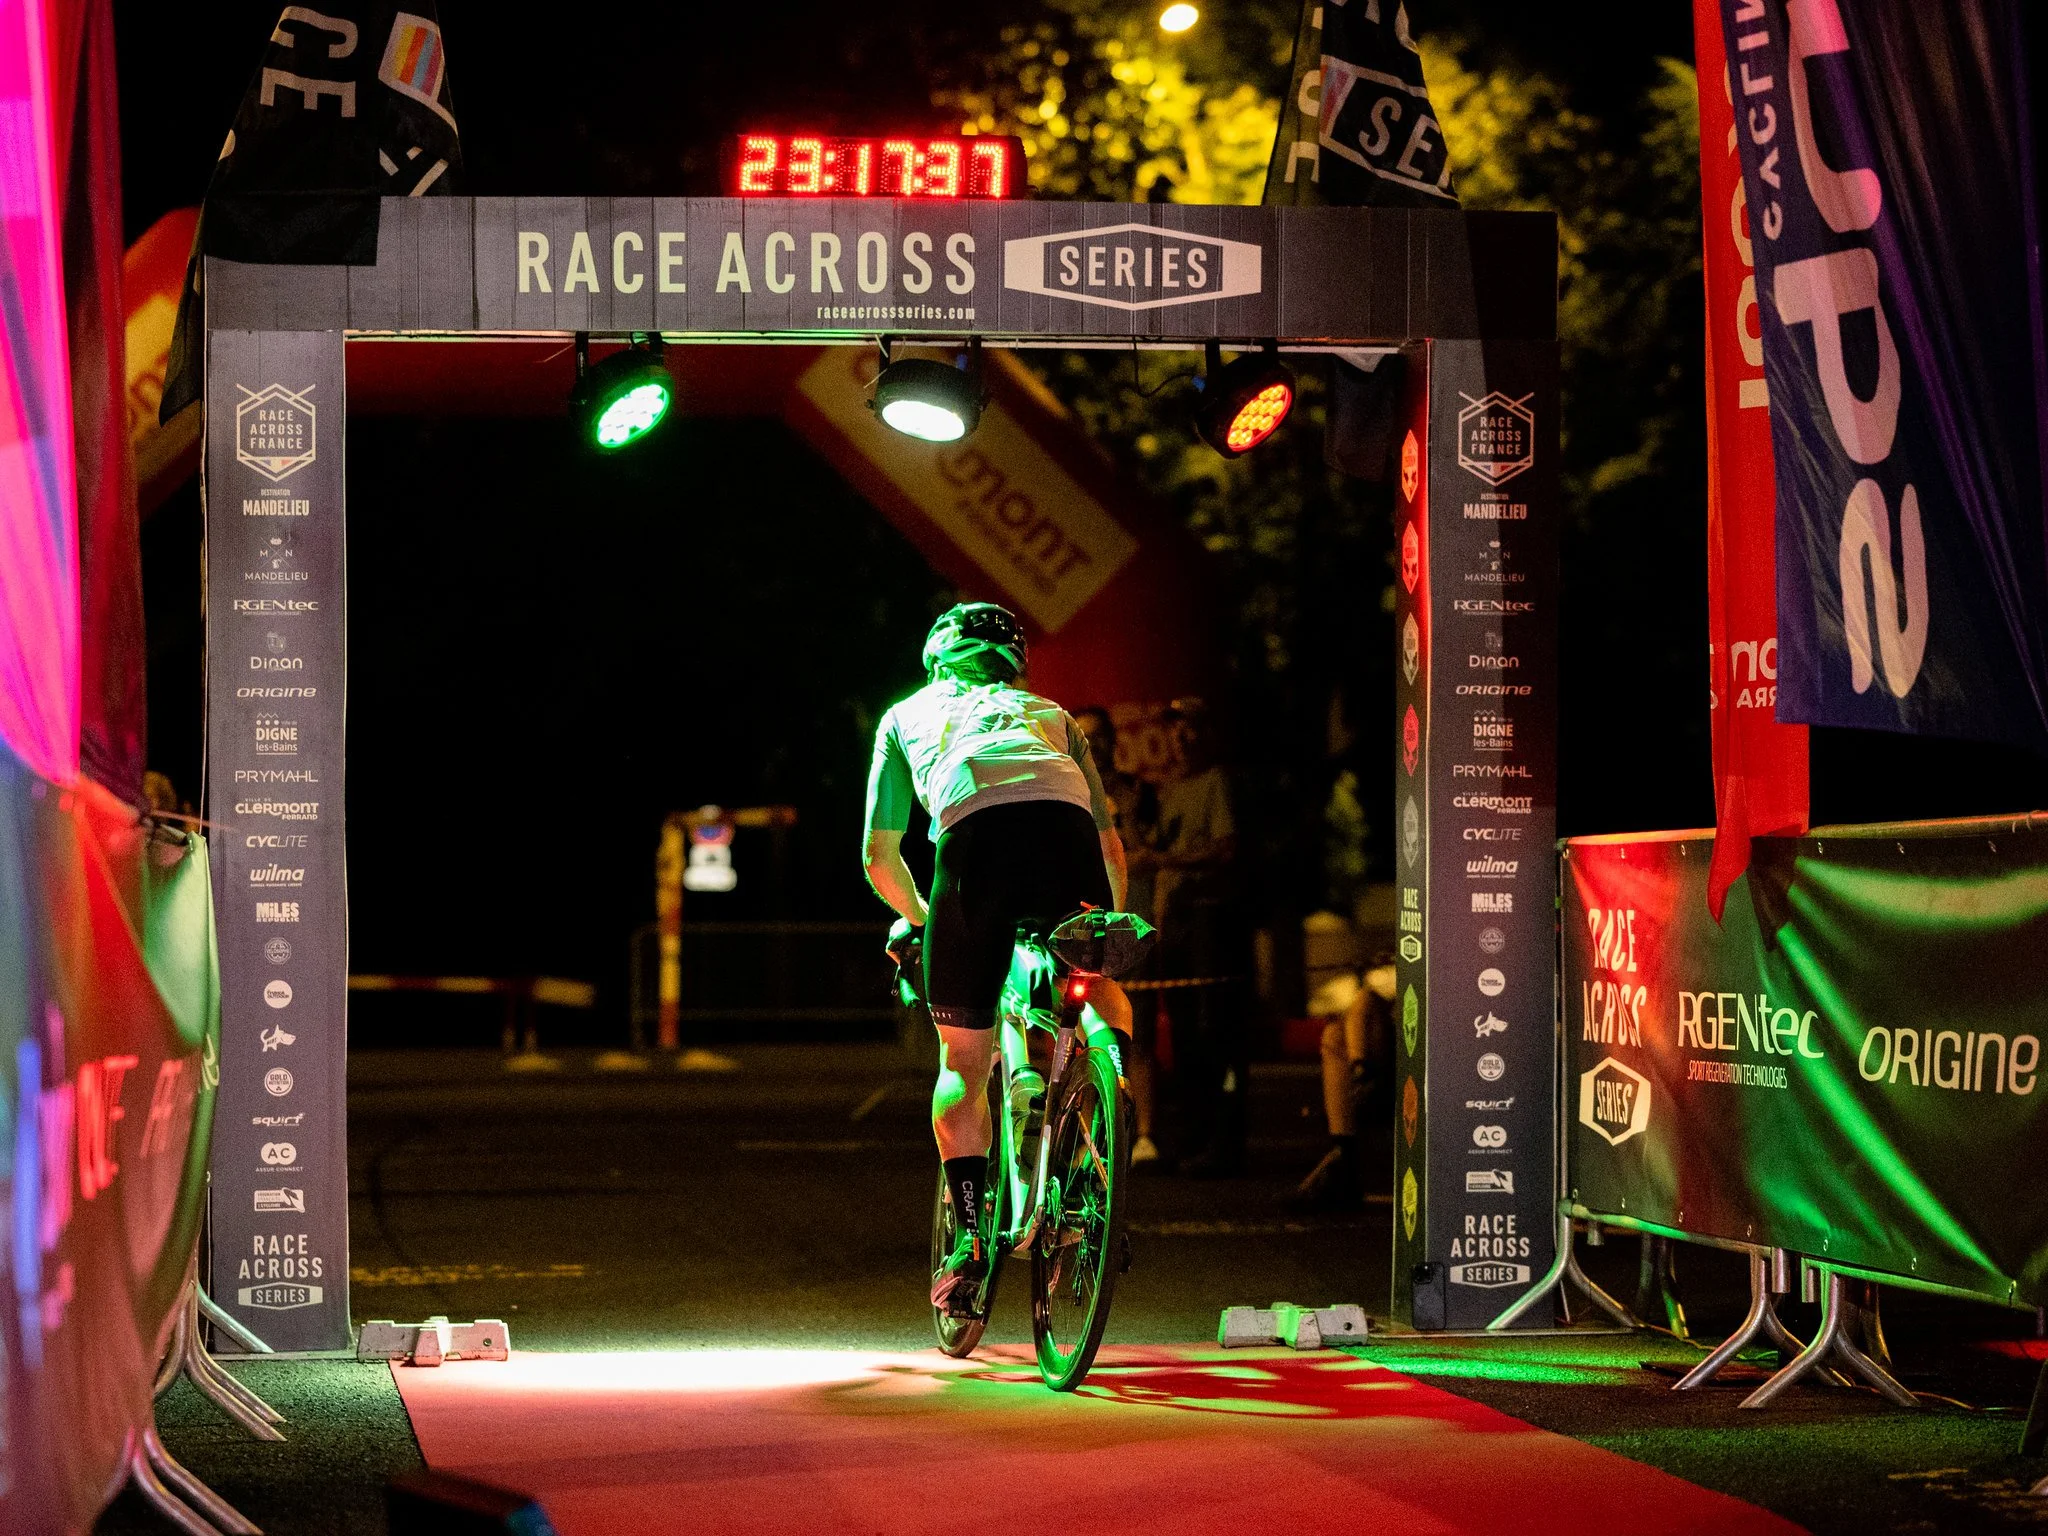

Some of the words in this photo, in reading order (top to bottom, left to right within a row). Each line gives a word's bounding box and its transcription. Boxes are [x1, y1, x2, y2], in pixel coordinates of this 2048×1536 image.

[742, 138, 1003, 197] 23:17:37
[518, 231, 687, 294] RACE
[715, 231, 976, 295] ACROSS
[1060, 245, 1209, 289] SERIES
[816, 305, 976, 320] raceacrossseries.com
[260, 410, 294, 421] RACE
[1480, 416, 1513, 428] RACE
[250, 424, 303, 435] ACROSS
[1471, 430, 1522, 442] ACROSS
[250, 437, 303, 449] FRANCE
[1471, 443, 1521, 455] FRANCE
[243, 499, 310, 516] MANDELIEU
[1463, 503, 1527, 520] MANDELIEU
[244, 572, 309, 581] MANDELIEU
[1464, 573, 1526, 582] MANDELIEU
[233, 599, 319, 611] RGENtec
[1453, 599, 1535, 611] RGENtec
[250, 656, 303, 669] Dinan
[1469, 654, 1519, 668] Dinan
[256, 727, 298, 741] DIGNE
[1473, 723, 1514, 737] DIGNE
[256, 741, 298, 752] les-Bains
[235, 770, 319, 783] PRYMAHL
[1453, 765, 1533, 778] PRYMAHL
[246, 835, 308, 848] CYCLITE
[1462, 828, 1522, 841] CYCLITE
[1466, 854, 1519, 873] wilma
[250, 862, 305, 882] wilma
[1587, 908, 1637, 973] RACE
[1582, 980, 1647, 1049] ACROSS
[1677, 991, 1825, 1059] RGENtec
[1687, 1059, 1706, 1081] SPORT
[1742, 1063, 1788, 1089] TECHNOLOGIES
[1465, 1098, 1514, 1110] squirt
[1596, 1079, 1634, 1125] SERIES
[252, 1113, 304, 1127] squirt
[962, 1180, 978, 1227] CRAFT
[1464, 1214, 1516, 1235] RACE
[253, 1234, 308, 1256] RACE
[1450, 1236, 1530, 1258] ACROSS
[238, 1257, 323, 1280] ACROSS
[1466, 1267, 1514, 1282] SERIES
[256, 1288, 306, 1304] SERIES
